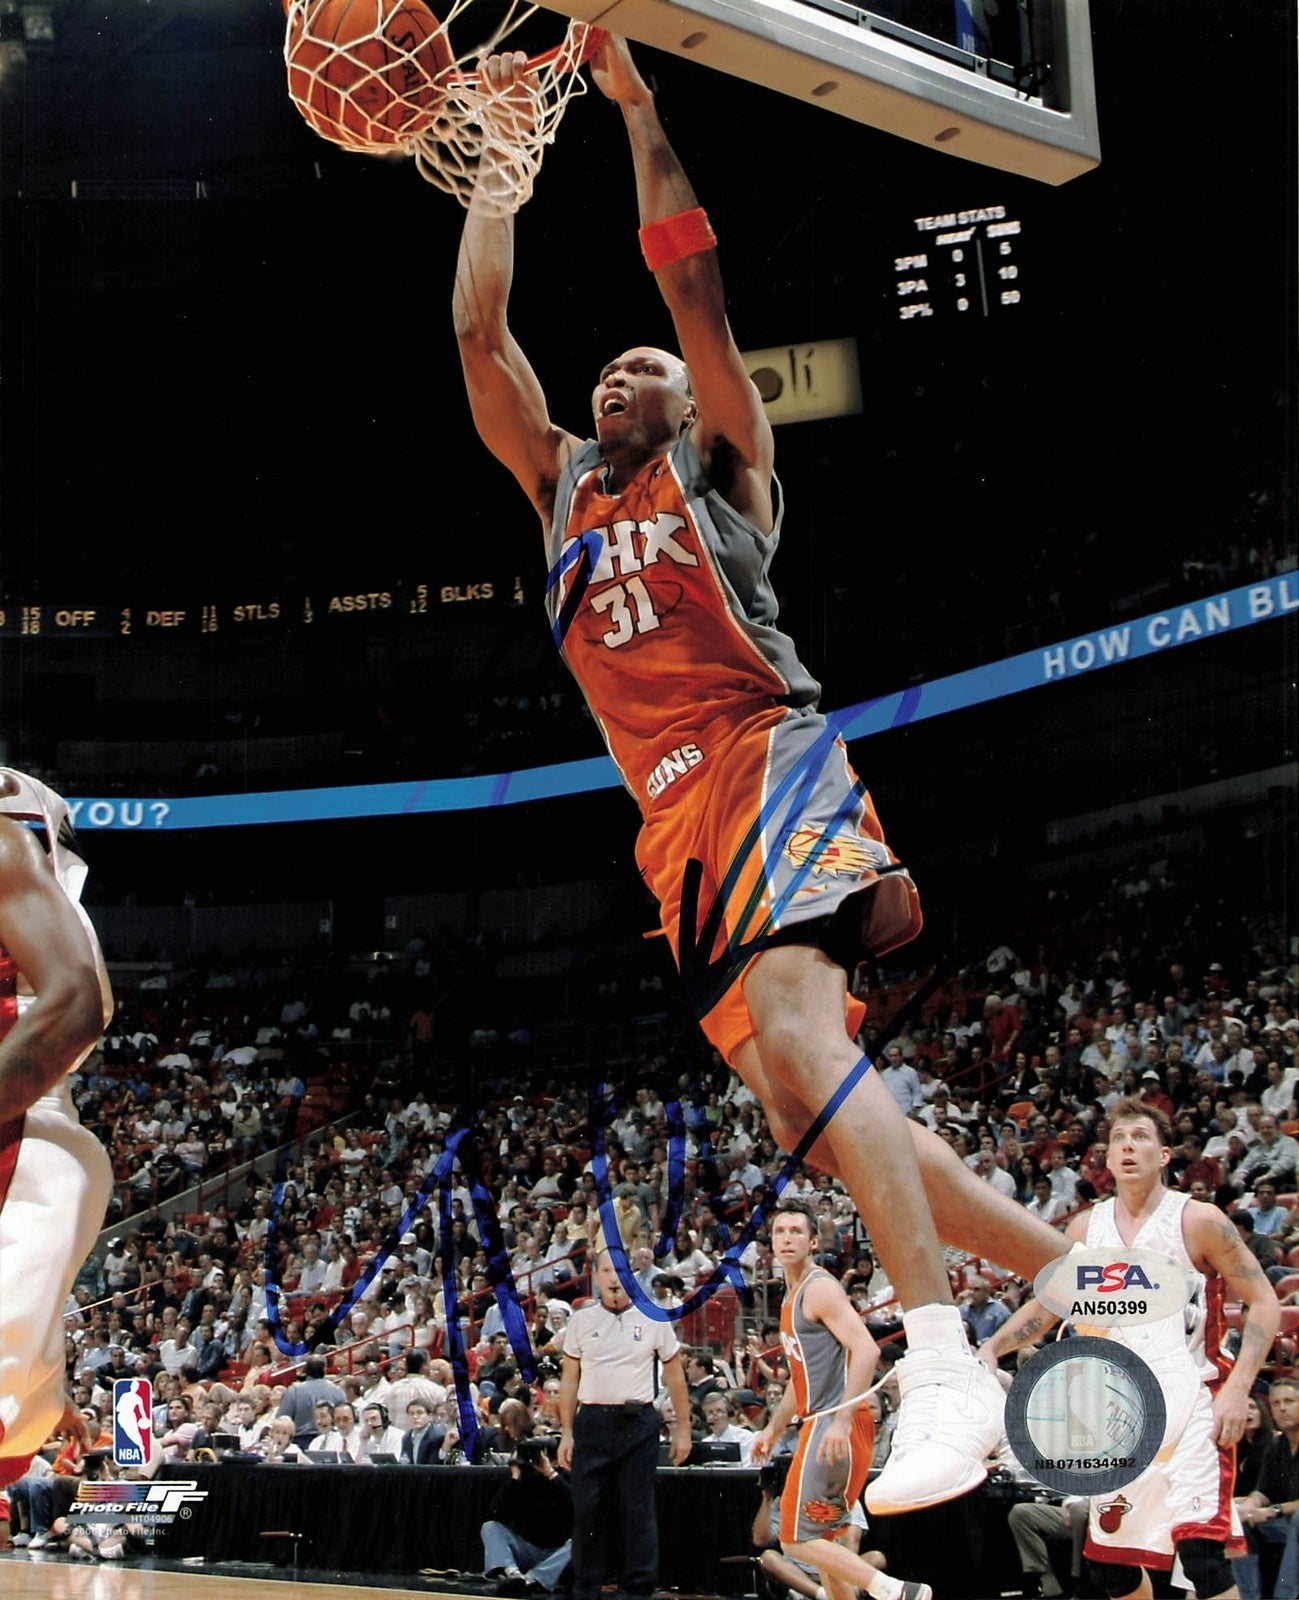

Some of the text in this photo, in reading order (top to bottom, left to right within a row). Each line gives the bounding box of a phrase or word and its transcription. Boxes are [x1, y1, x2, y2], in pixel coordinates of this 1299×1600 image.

[914, 206, 1006, 231] TEAM STATS
[1000, 242, 1012, 255] 5
[955, 273, 966, 287] 3
[998, 265, 1018, 280] 10
[897, 279, 928, 296] 3PA
[416, 585, 428, 598] 5
[440, 583, 494, 603] BLKS
[513, 590, 524, 604] 4
[328, 592, 392, 614] ASSTS
[409, 599, 428, 613] 12
[22, 607, 40, 620] 15
[55, 610, 96, 626] OFF
[121, 608, 131, 619] 4
[146, 611, 186, 626] DEF
[233, 603, 281, 621] STLS
[303, 610, 314, 623] 3
[590, 575, 661, 649] 31
[120, 620, 131, 635] 2
[1043, 627, 1131, 678] HOW
[1147, 597, 1231, 647] CAN
[70, 802, 170, 826] YOU?
[1070, 1301, 1148, 1316] AN50399
